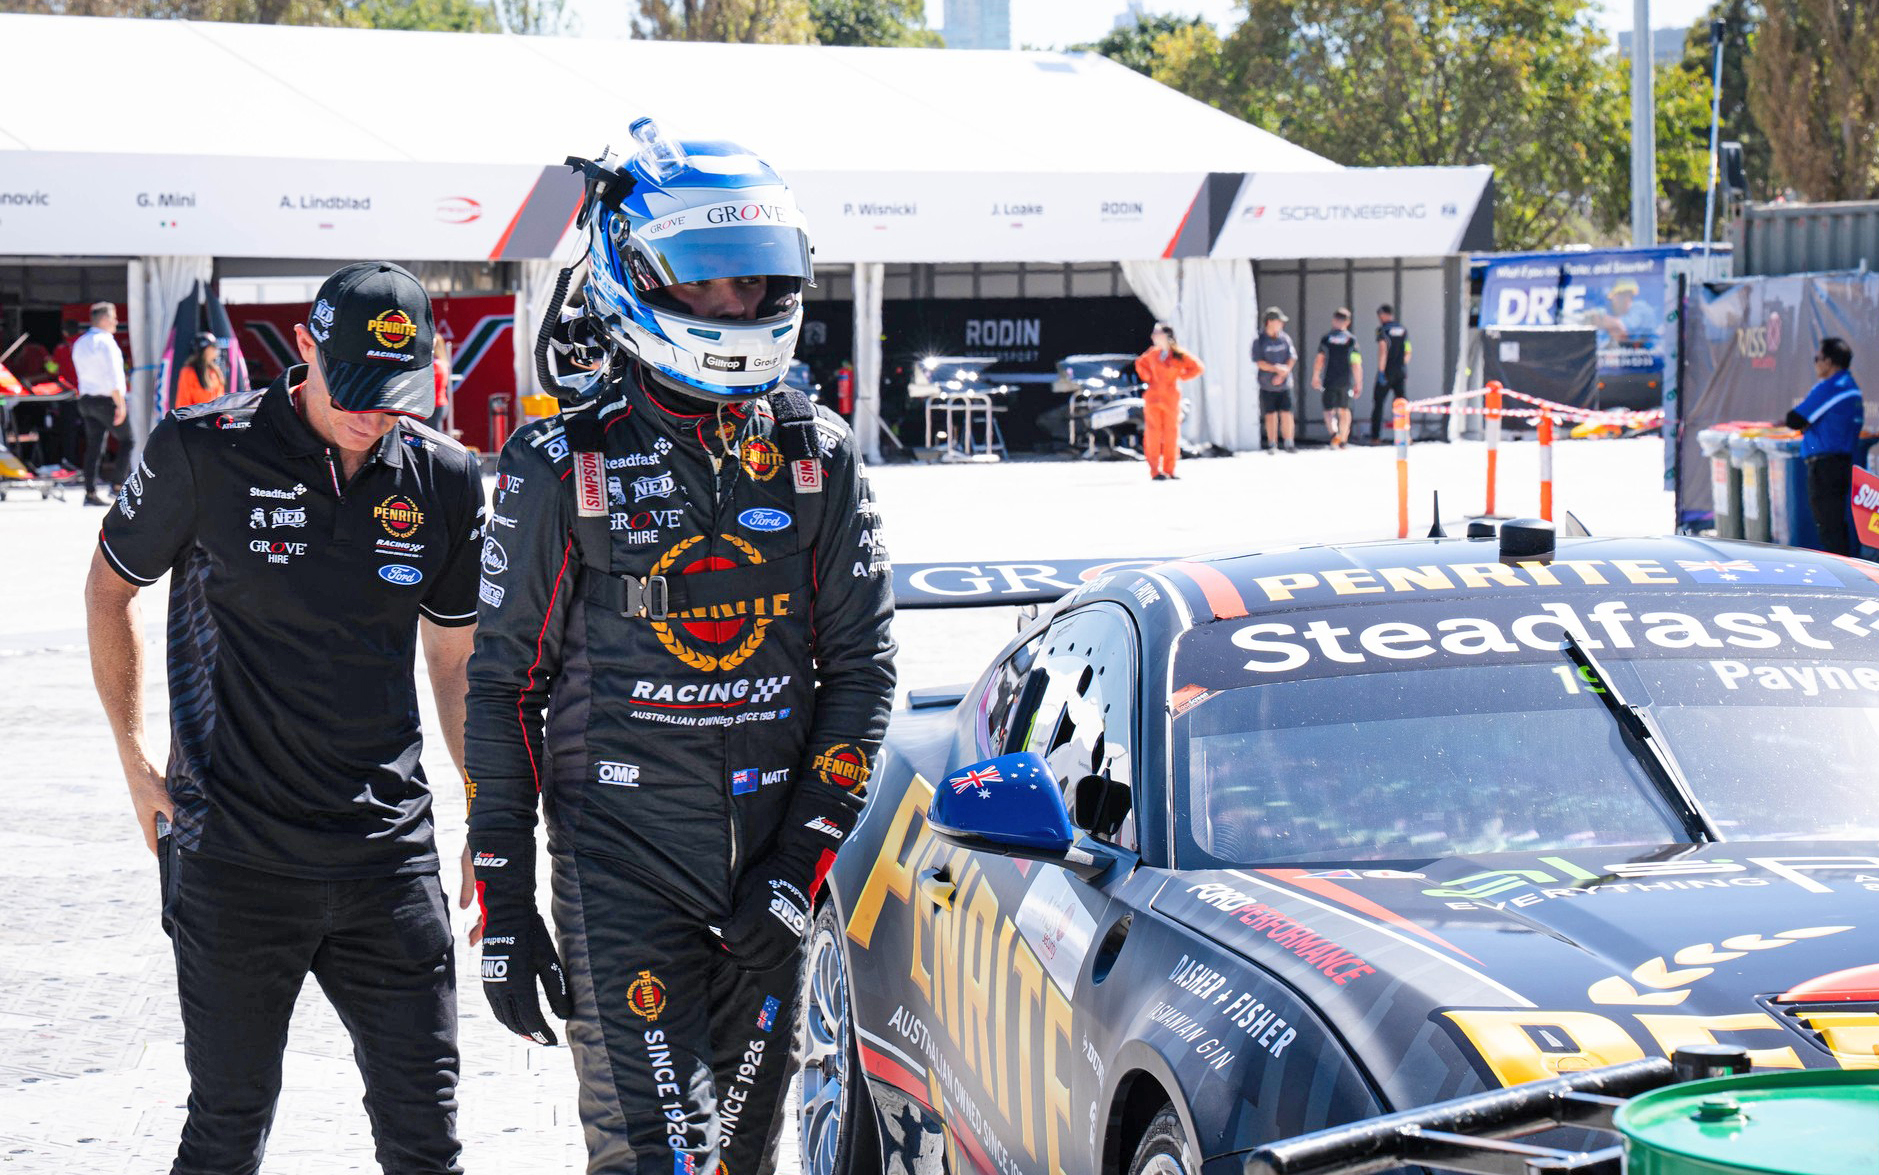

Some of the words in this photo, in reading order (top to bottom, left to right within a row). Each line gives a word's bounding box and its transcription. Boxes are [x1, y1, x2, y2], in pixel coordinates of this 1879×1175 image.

[0, 190, 49, 206] novic
[136, 193, 154, 207] G.
[158, 193, 196, 207] Mini
[279, 196, 295, 209] A.
[301, 195, 371, 210] Lindblad
[707, 203, 788, 225] GROVE
[844, 204, 855, 215] P.
[859, 203, 917, 216] Wisnicki
[1003, 203, 1044, 216] Loake
[1100, 202, 1144, 216] RODIN
[1278, 204, 1427, 222] SCRUTINEERING
[650, 216, 686, 234] GROVE
[367, 319, 417, 338] PENRITE
[965, 318, 1041, 347] RODIN
[366, 349, 403, 361] RACING
[705, 355, 741, 370] Giltrap
[753, 354, 781, 369] Group
[221, 421, 252, 430] ATHLETIC
[605, 452, 660, 470] teadfast
[741, 448, 785, 467] ENRITE
[582, 451, 600, 508] SIMPSON
[634, 475, 675, 498] NED
[249, 486, 297, 501] Steadfast
[271, 510, 307, 525] NED
[373, 505, 425, 525] PENRITE
[375, 538, 412, 551] RACING
[628, 529, 659, 545] HIRE
[249, 539, 306, 556] GROVE
[268, 553, 289, 565] HIRE
[386, 565, 416, 584] Ford
[1253, 558, 1680, 603] PENRITE
[1230, 600, 1835, 674] Steadfast
[1709, 660, 1879, 697] Payne
[631, 679, 750, 703] RACING
[630, 710, 697, 726] AUSTRALIAN
[759, 710, 776, 722] 1926
[599, 763, 640, 784] OMP
[761, 768, 790, 785] MATT
[812, 755, 869, 784] PENRIT
[1444, 876, 1772, 912] EVERYTHING
[770, 897, 805, 931] OMP
[1185, 882, 1258, 913] FORD
[1229, 902, 1377, 987] PERFORMANCE
[845, 772, 1074, 1175] PENRITE
[637, 969, 659, 1023] PENRITE
[1167, 953, 1228, 1001] DASHER
[1222, 991, 1297, 1059] FISHER
[1145, 1000, 1208, 1044] TASMANIAN
[1195, 1037, 1236, 1071] GIN
[644, 1029, 681, 1098] SINCE
[718, 1085, 748, 1149] SINCE
[735, 1039, 766, 1086] 1926
[887, 1005, 954, 1094] AUSTRALIAN
[953, 1076, 983, 1136] OWNED
[983, 1119, 1009, 1175] SINCE
[661, 1100, 689, 1149] 1926
